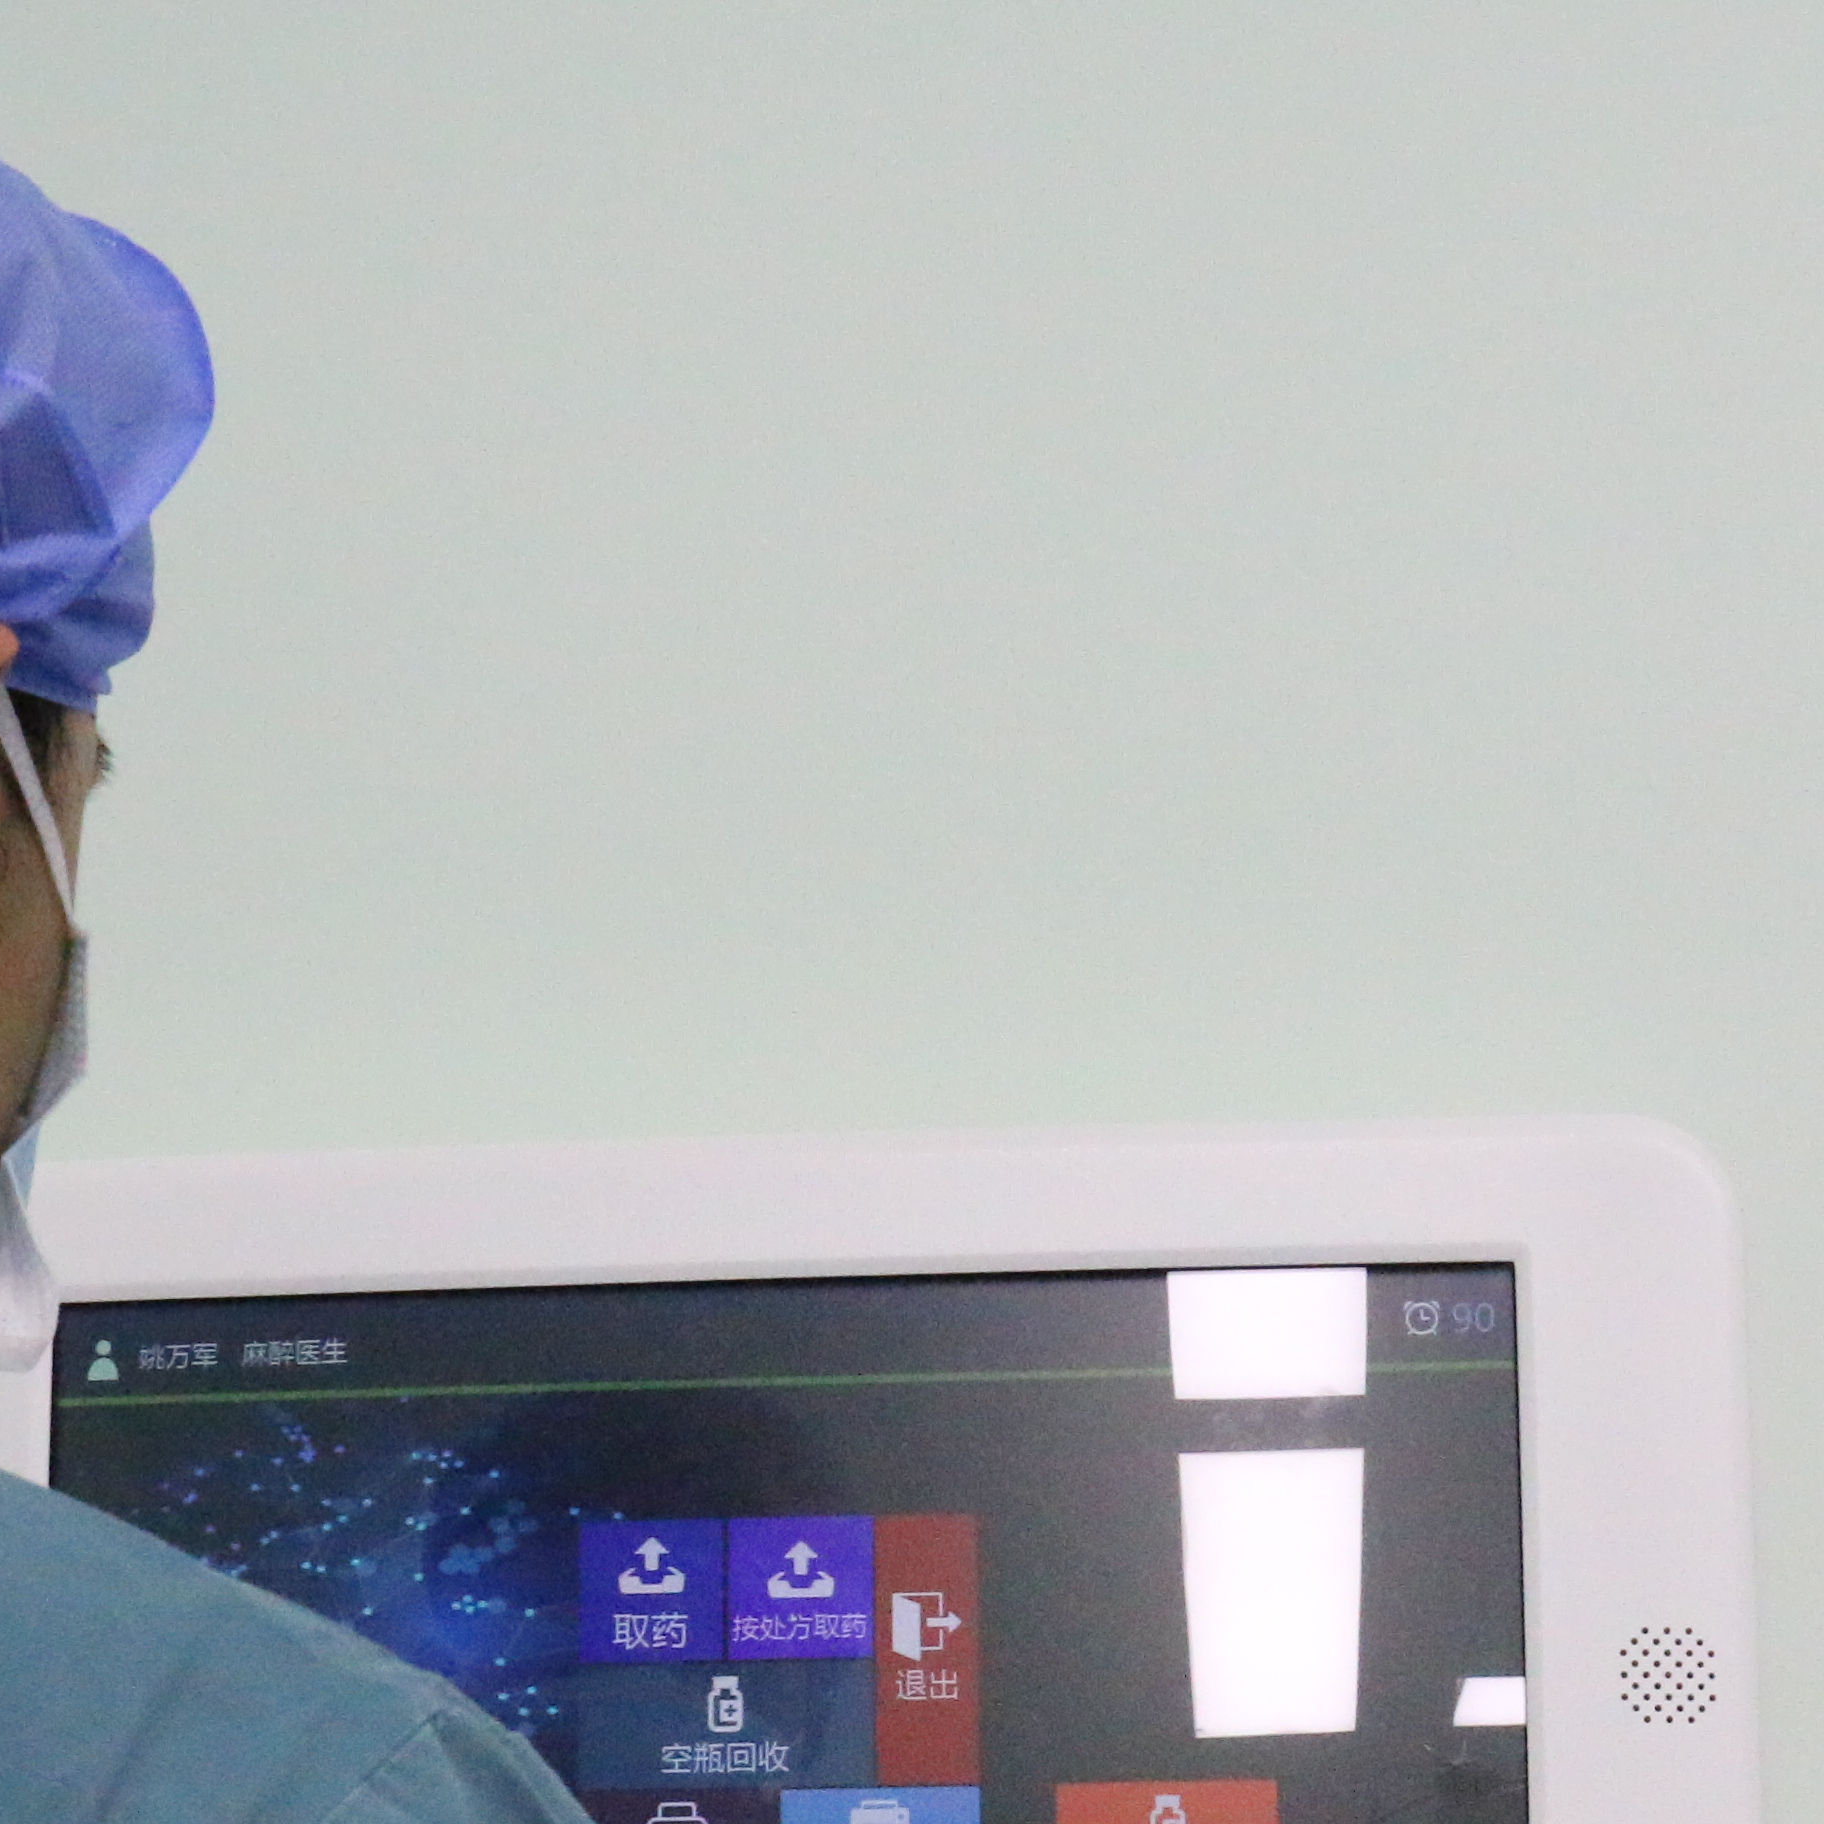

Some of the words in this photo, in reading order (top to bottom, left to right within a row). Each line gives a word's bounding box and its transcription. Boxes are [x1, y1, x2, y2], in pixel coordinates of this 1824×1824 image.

[1453, 1302, 1495, 1333] 90
[138, 1342, 218, 1370] 姚万军
[242, 1337, 348, 1367] 麻醉医生
[612, 1612, 689, 1649] 取药
[732, 1613, 867, 1644] 按处方取药
[896, 1669, 959, 1701] 退出
[661, 1741, 790, 1774] 空瓶回收
